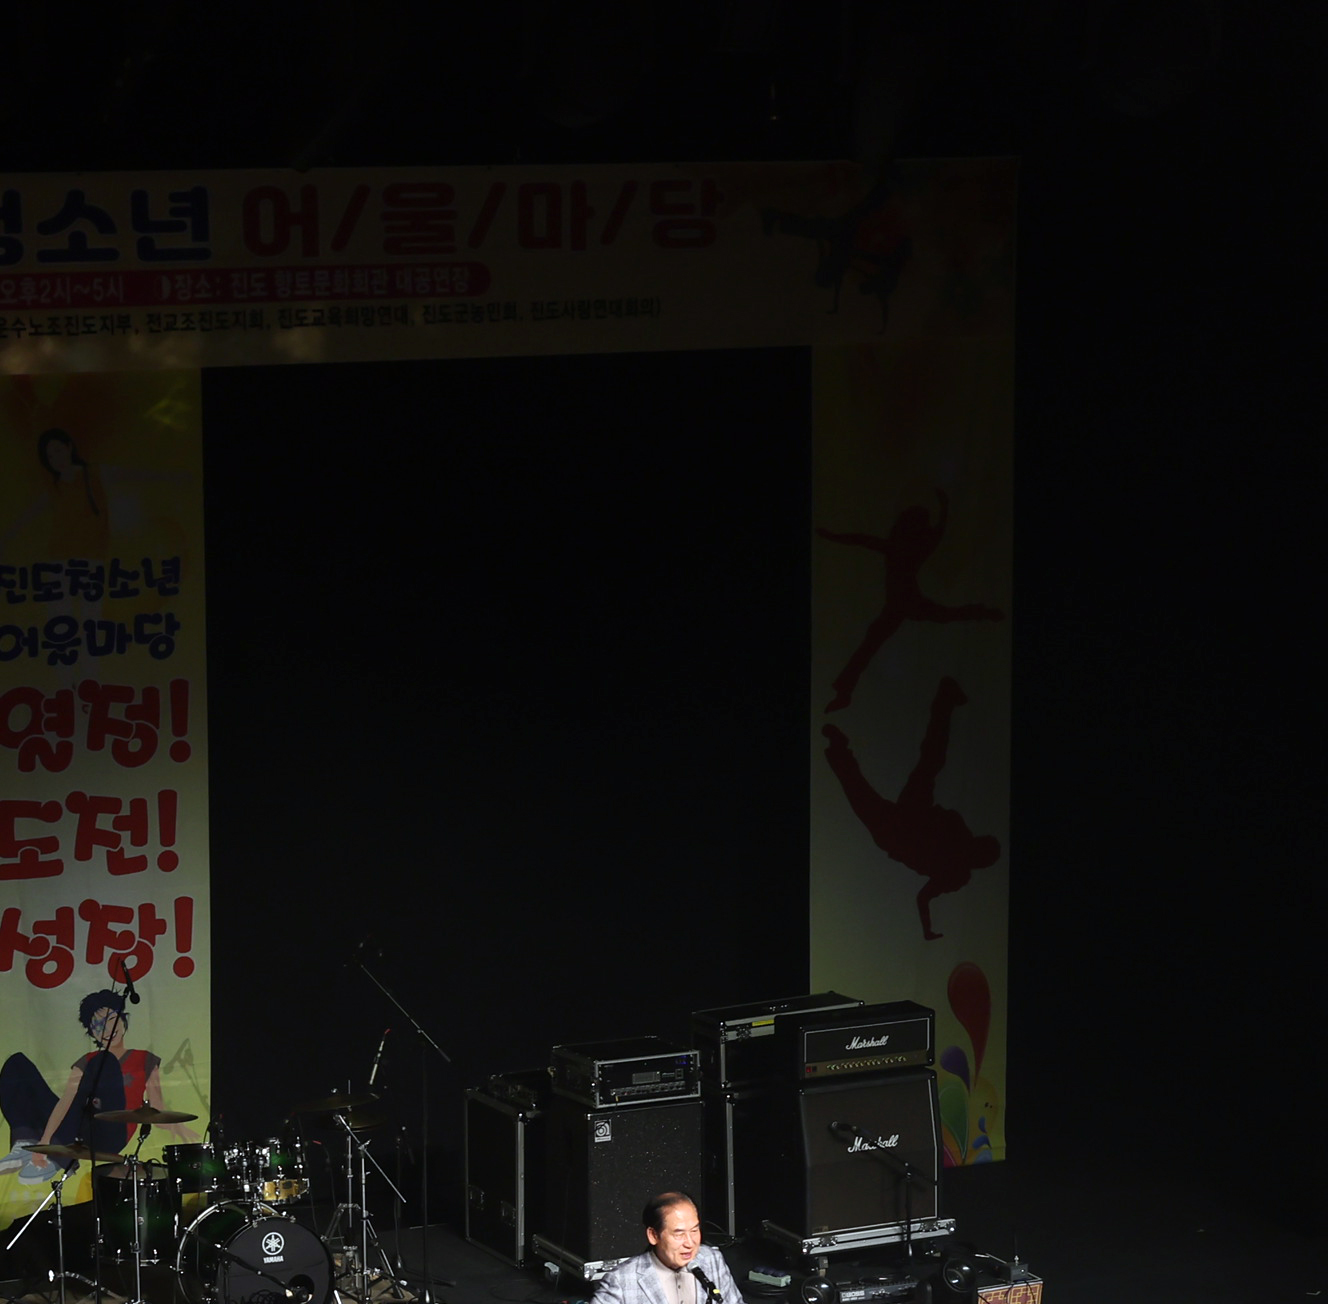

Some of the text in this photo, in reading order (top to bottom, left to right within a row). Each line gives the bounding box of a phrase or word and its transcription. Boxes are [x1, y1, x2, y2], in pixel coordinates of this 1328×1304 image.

[230, 271, 269, 299] 진도
[274, 268, 388, 299] 향토문화회관
[396, 265, 470, 295] 대공연장
[845, 1035, 889, 1050] Marshall
